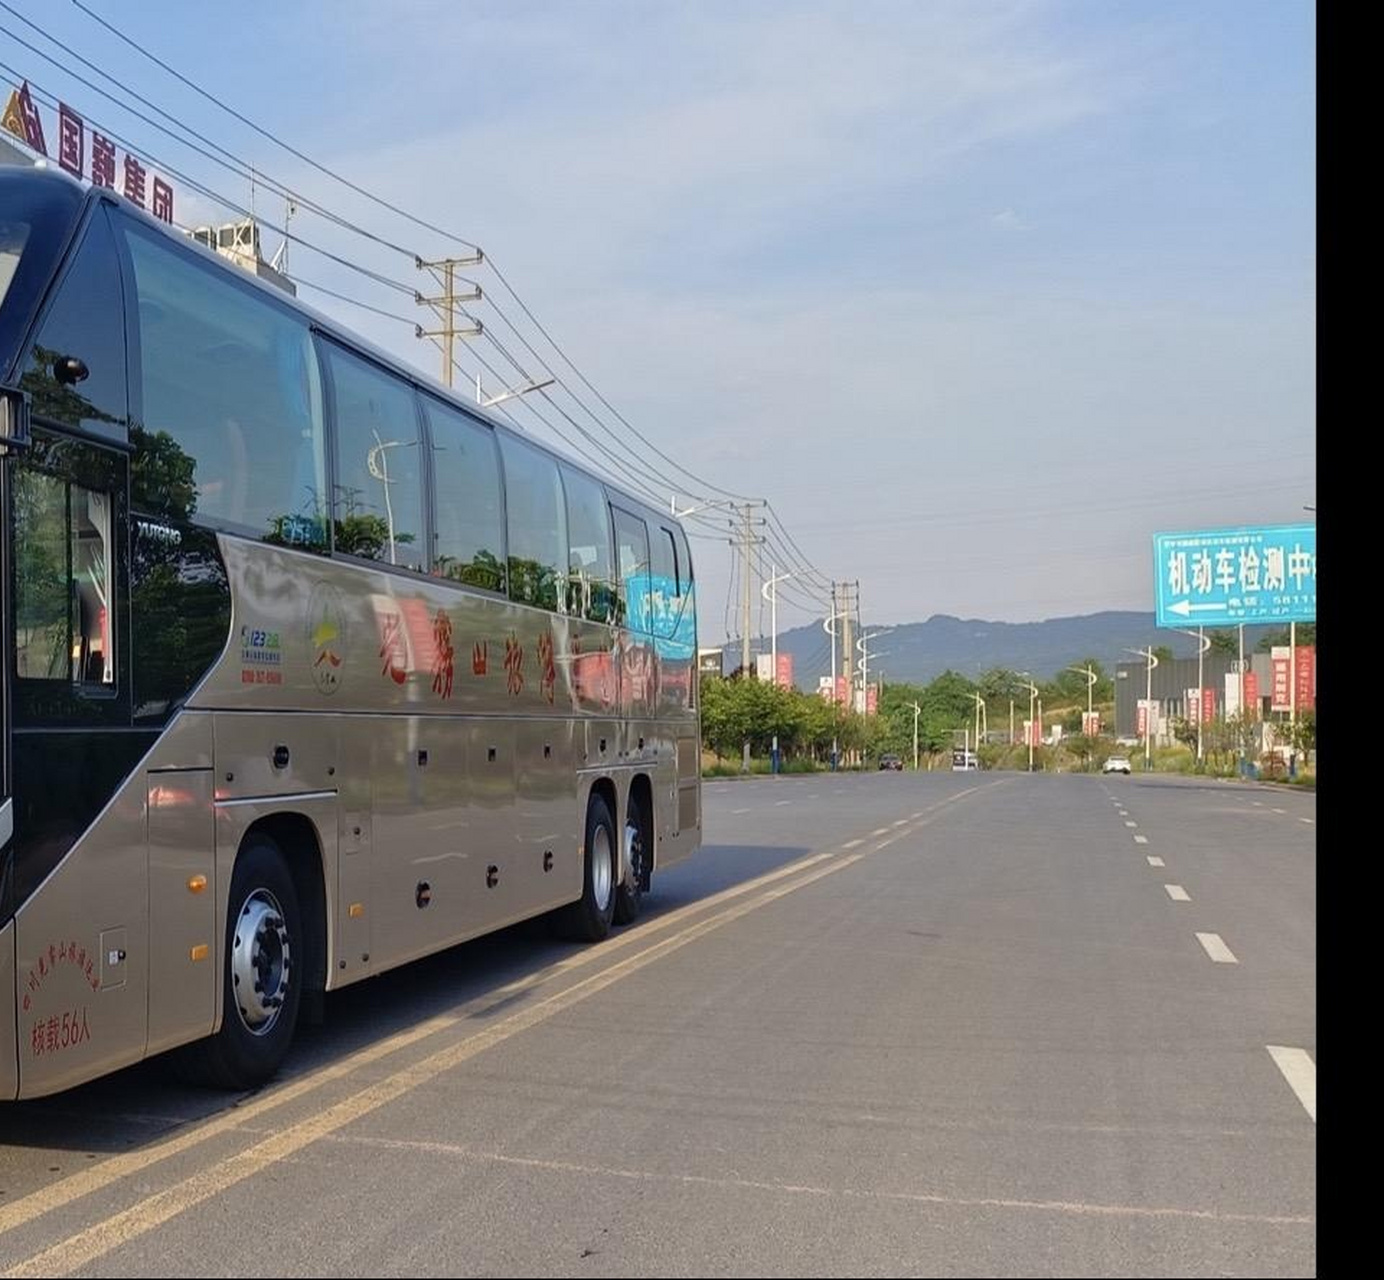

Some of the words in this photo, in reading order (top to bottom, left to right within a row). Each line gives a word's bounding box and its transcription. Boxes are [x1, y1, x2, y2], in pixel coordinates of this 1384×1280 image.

[137, 521, 183, 546] YUTONG
[1168, 543, 1316, 596] 机动车检测中
[31, 1007, 91, 1056] 核载56人
